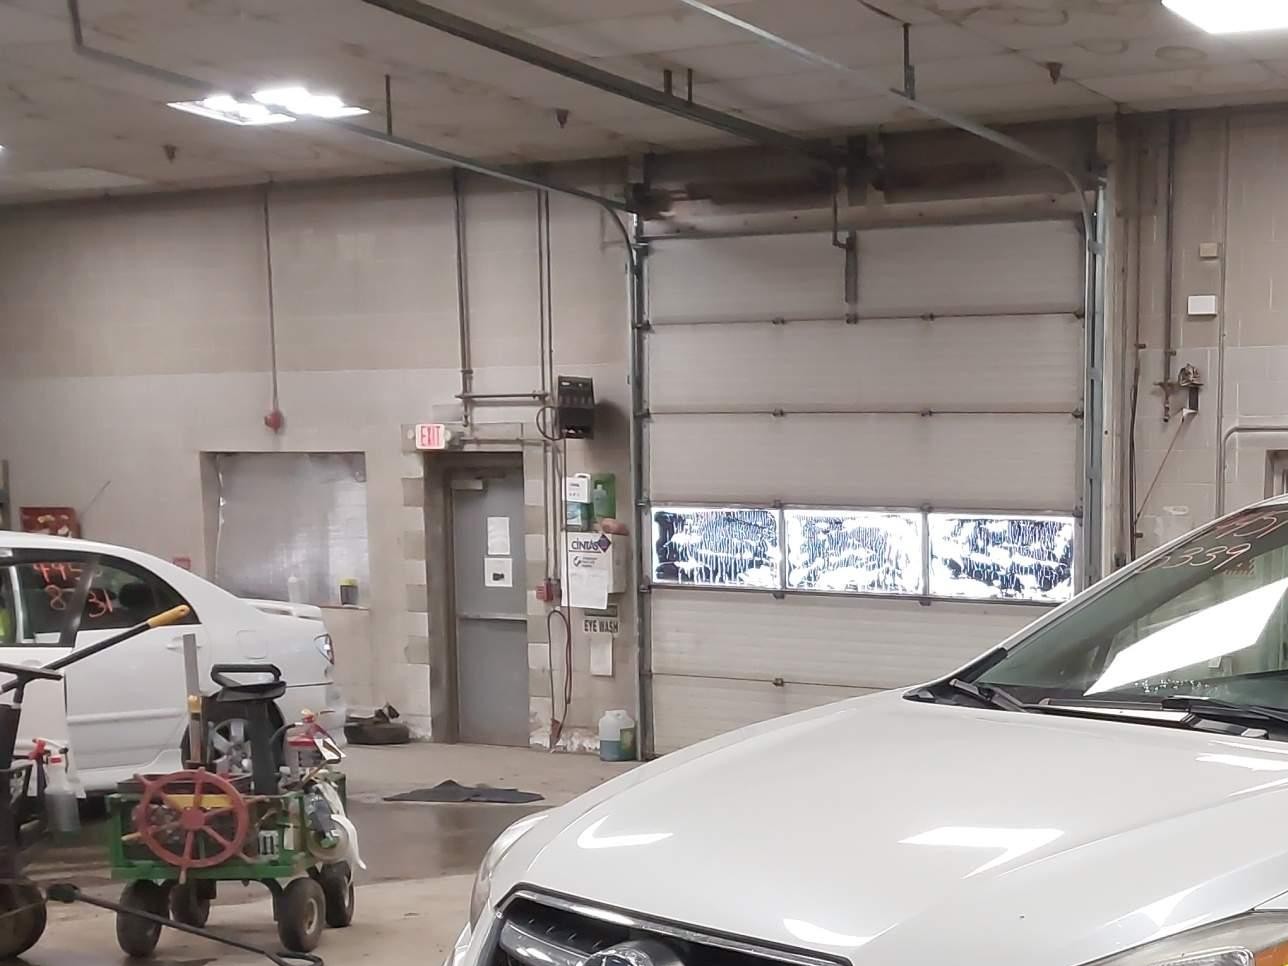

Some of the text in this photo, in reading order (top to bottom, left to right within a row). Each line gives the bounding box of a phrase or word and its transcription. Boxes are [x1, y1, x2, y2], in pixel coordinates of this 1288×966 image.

[420, 426, 440, 446] EXIT
[584, 619, 619, 632] EYE WASH
